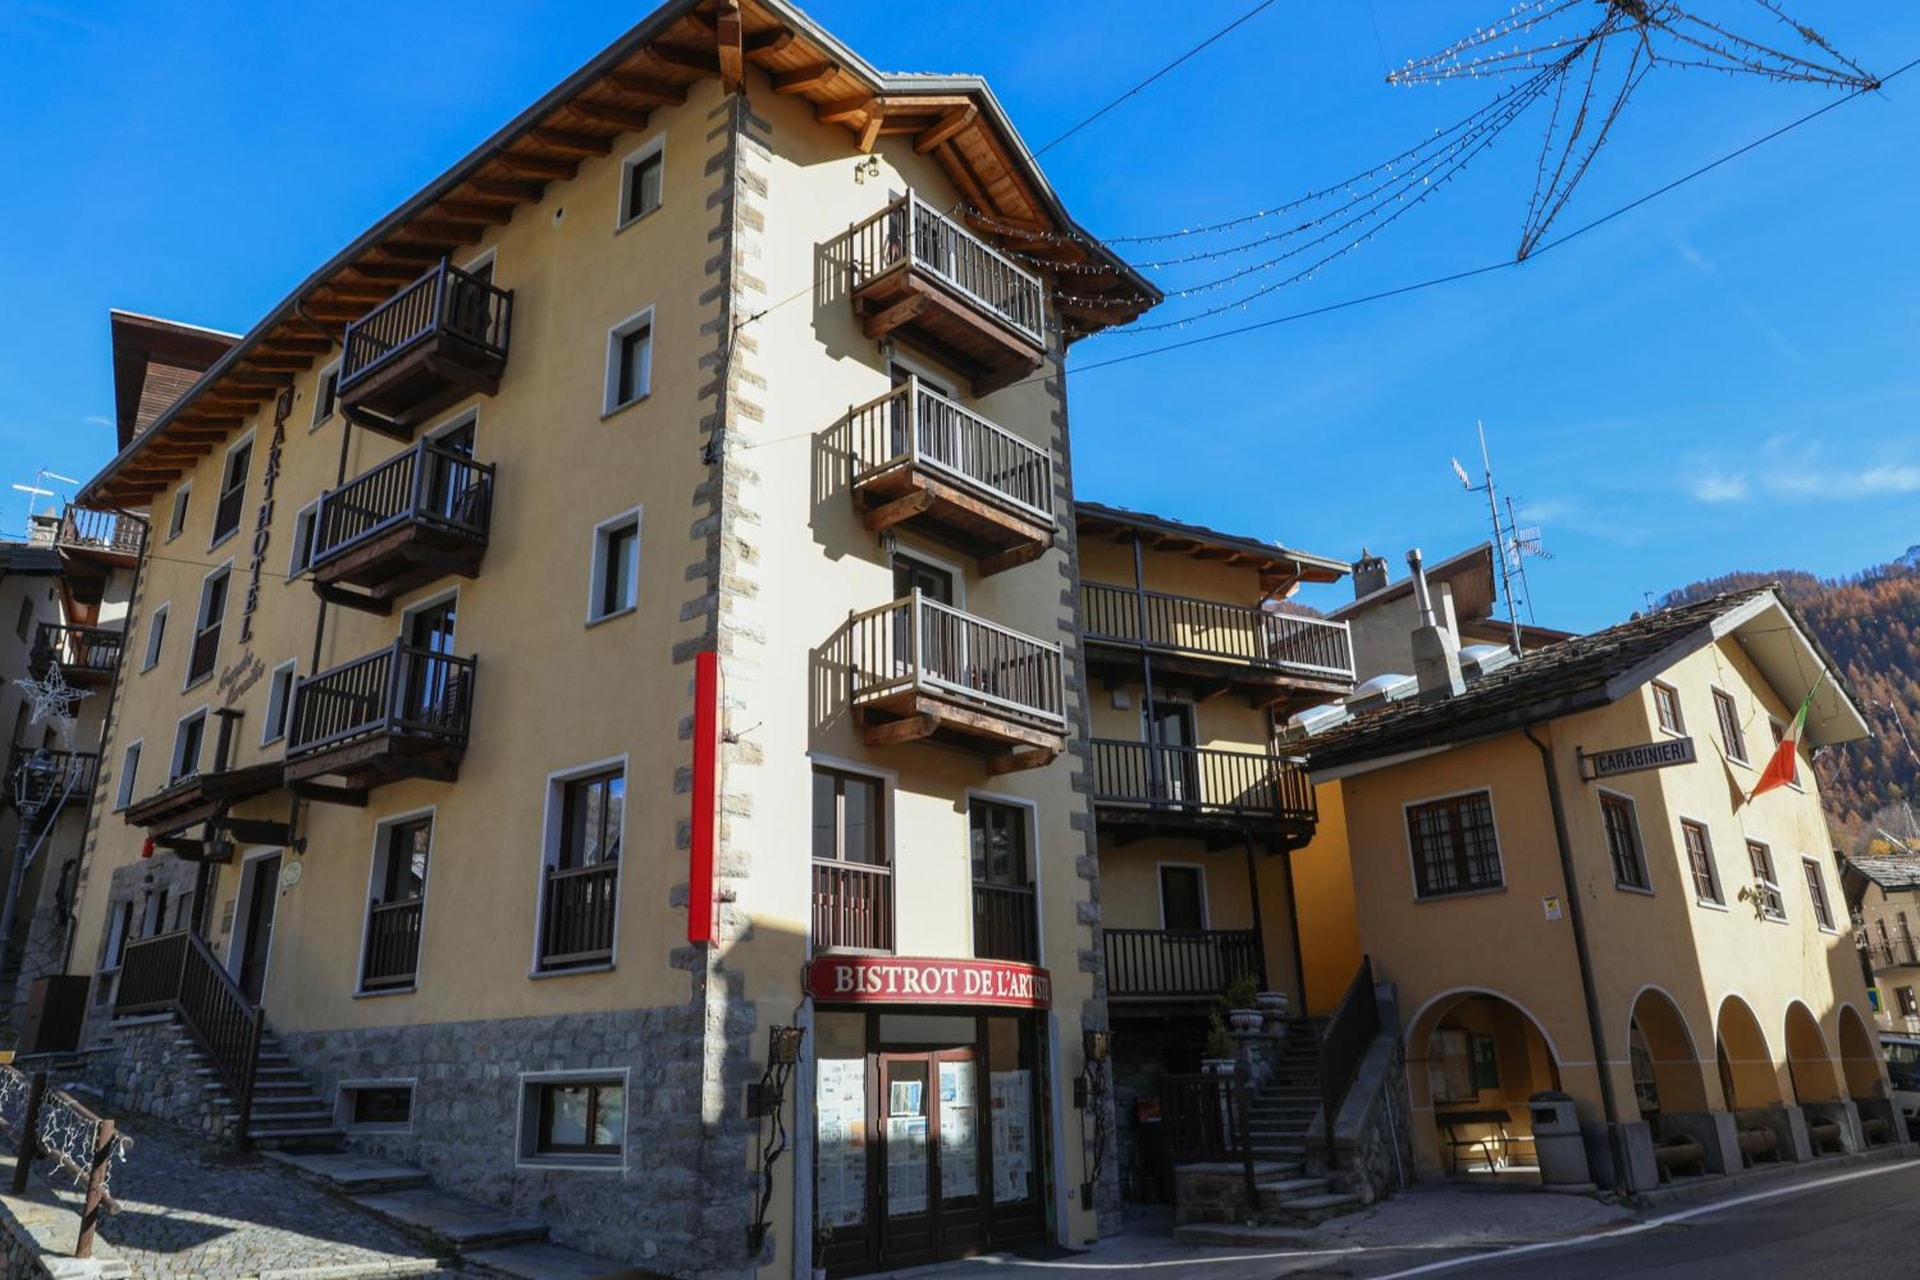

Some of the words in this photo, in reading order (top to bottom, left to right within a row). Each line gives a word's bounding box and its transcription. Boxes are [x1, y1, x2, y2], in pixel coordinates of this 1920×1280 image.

[1600, 742, 1687, 772] CARABINIERI
[834, 965, 958, 994] BISTROT
[963, 969, 994, 995] DE
